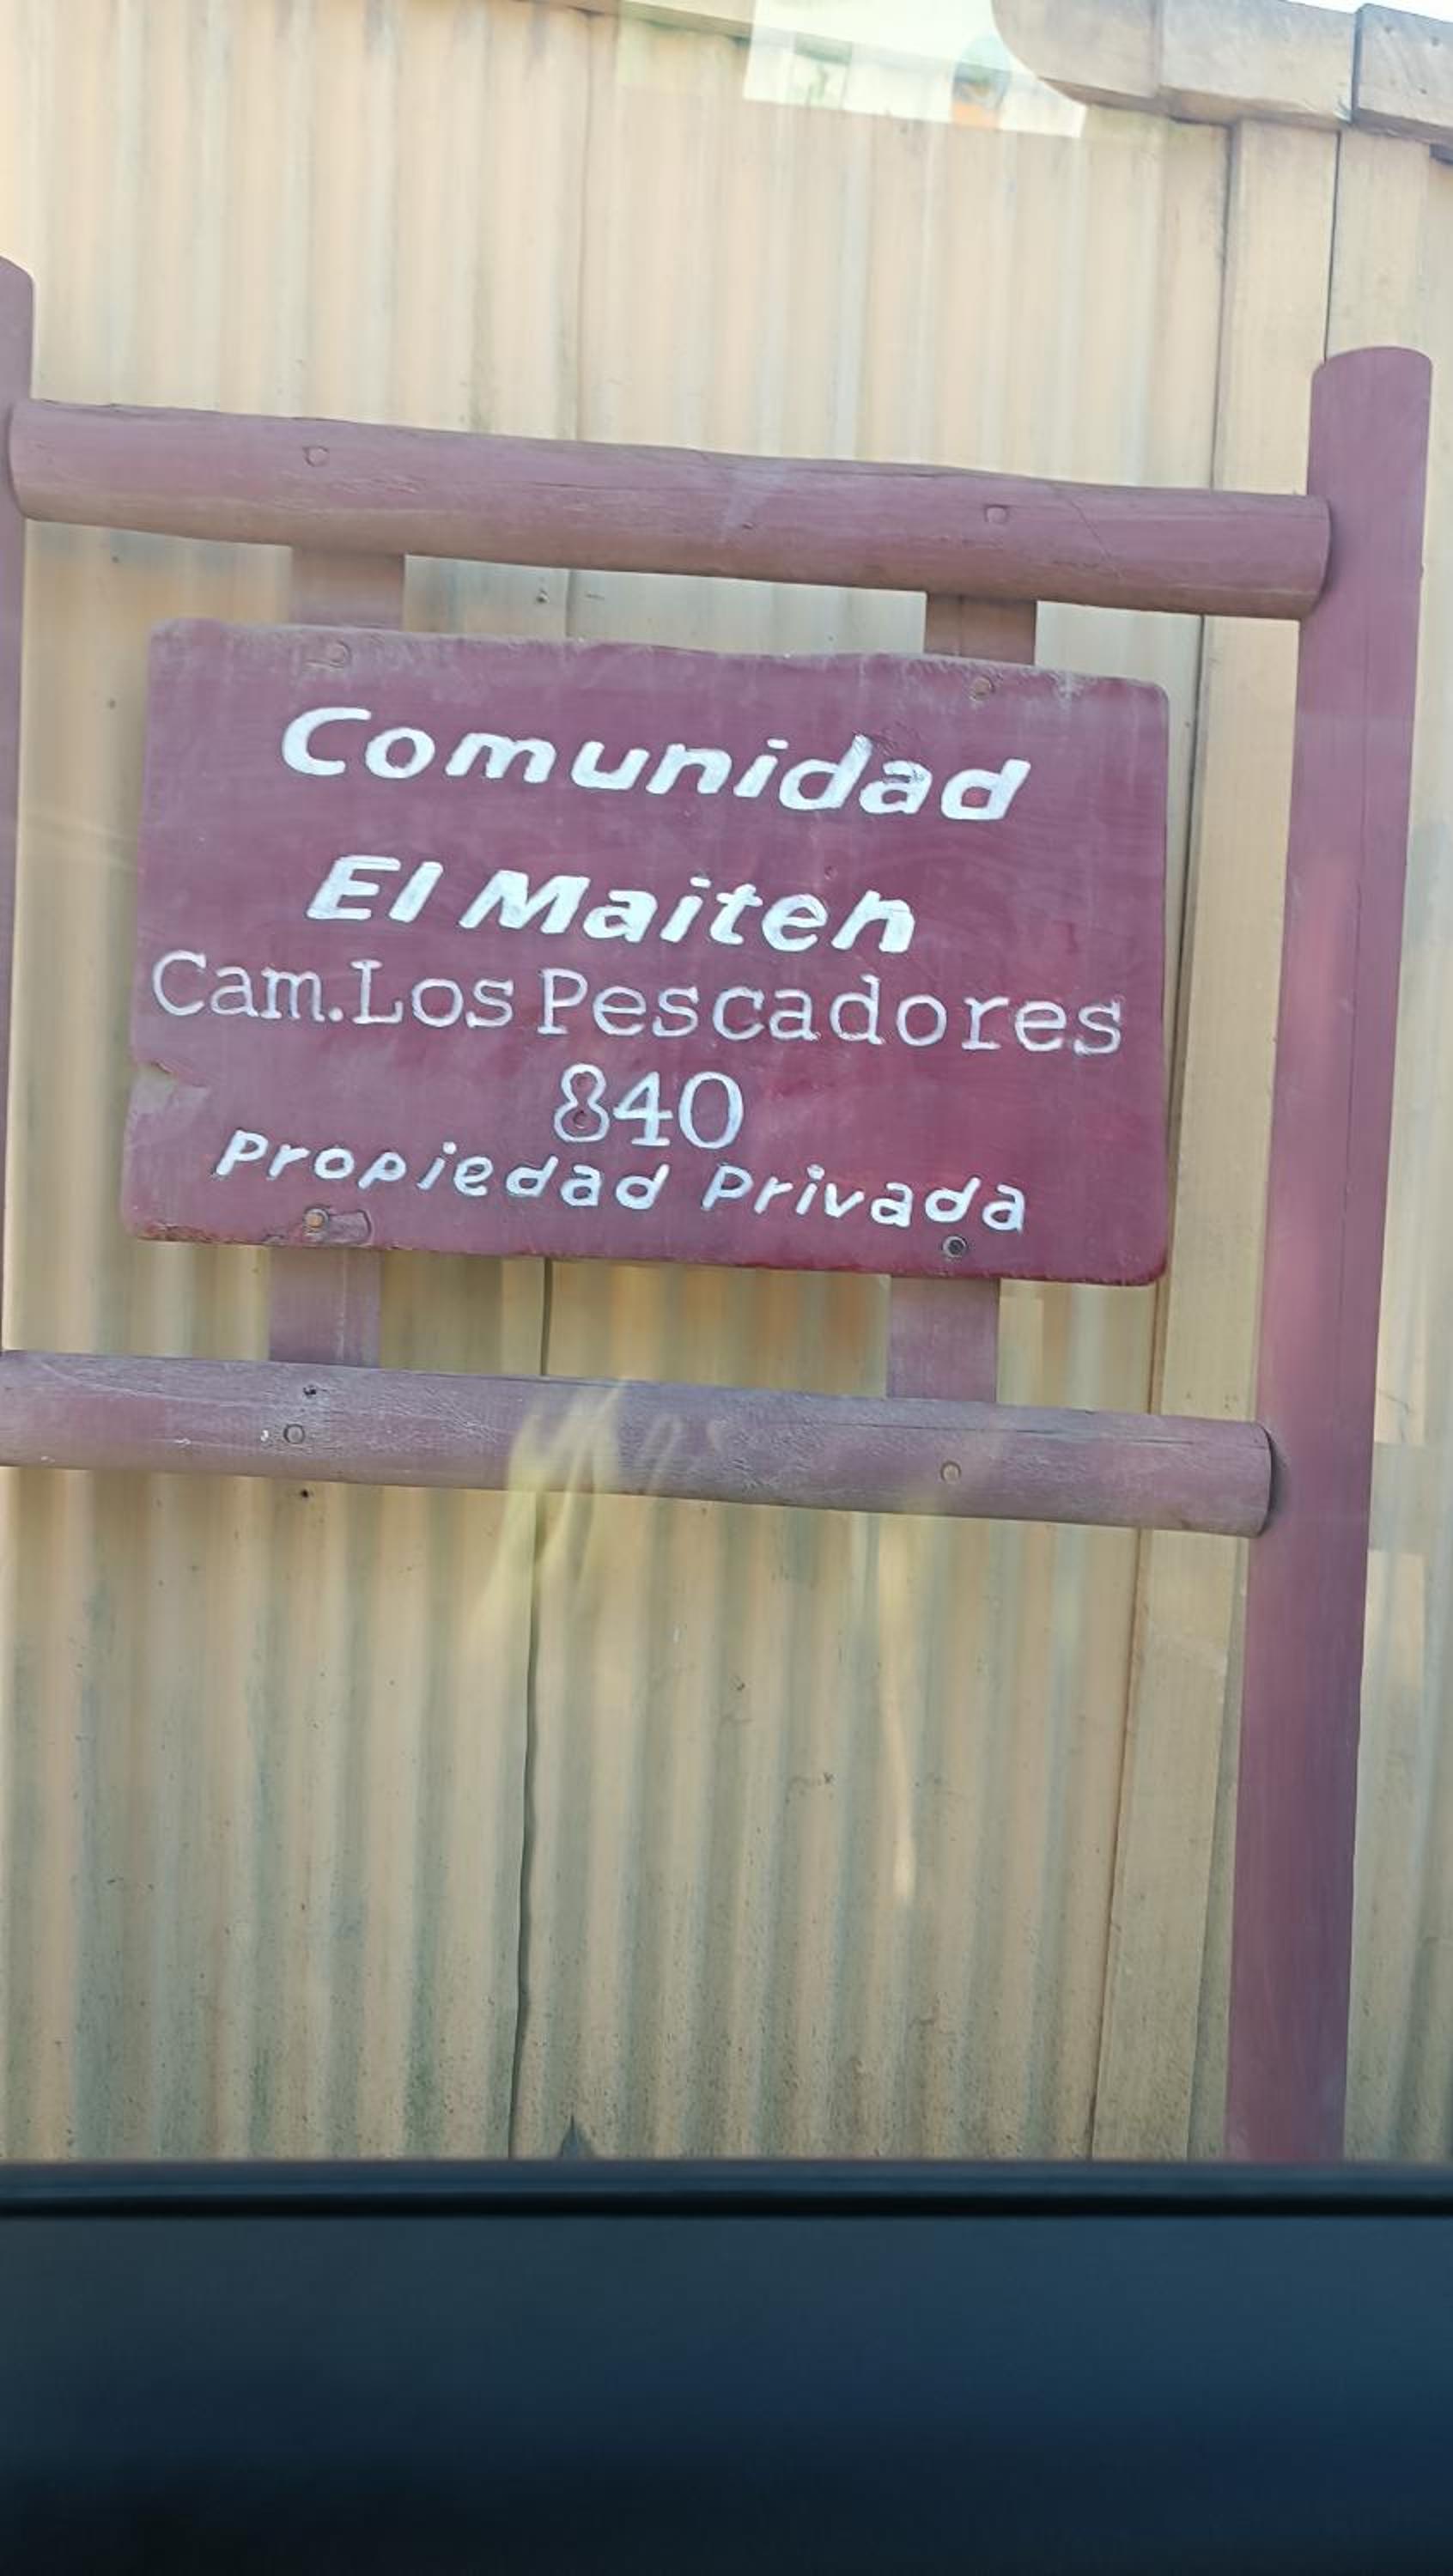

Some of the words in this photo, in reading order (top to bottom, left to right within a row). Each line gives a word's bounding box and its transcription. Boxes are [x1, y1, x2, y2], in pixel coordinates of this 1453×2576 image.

[282, 706, 1031, 822] Comunidad
[306, 854, 445, 924] El
[458, 869, 916, 954] Maiten
[537, 967, 1122, 1056] Pescadores
[553, 1062, 745, 1151] 840
[215, 1128, 671, 1211] Propiedad
[702, 1163, 1025, 1232] Privada
